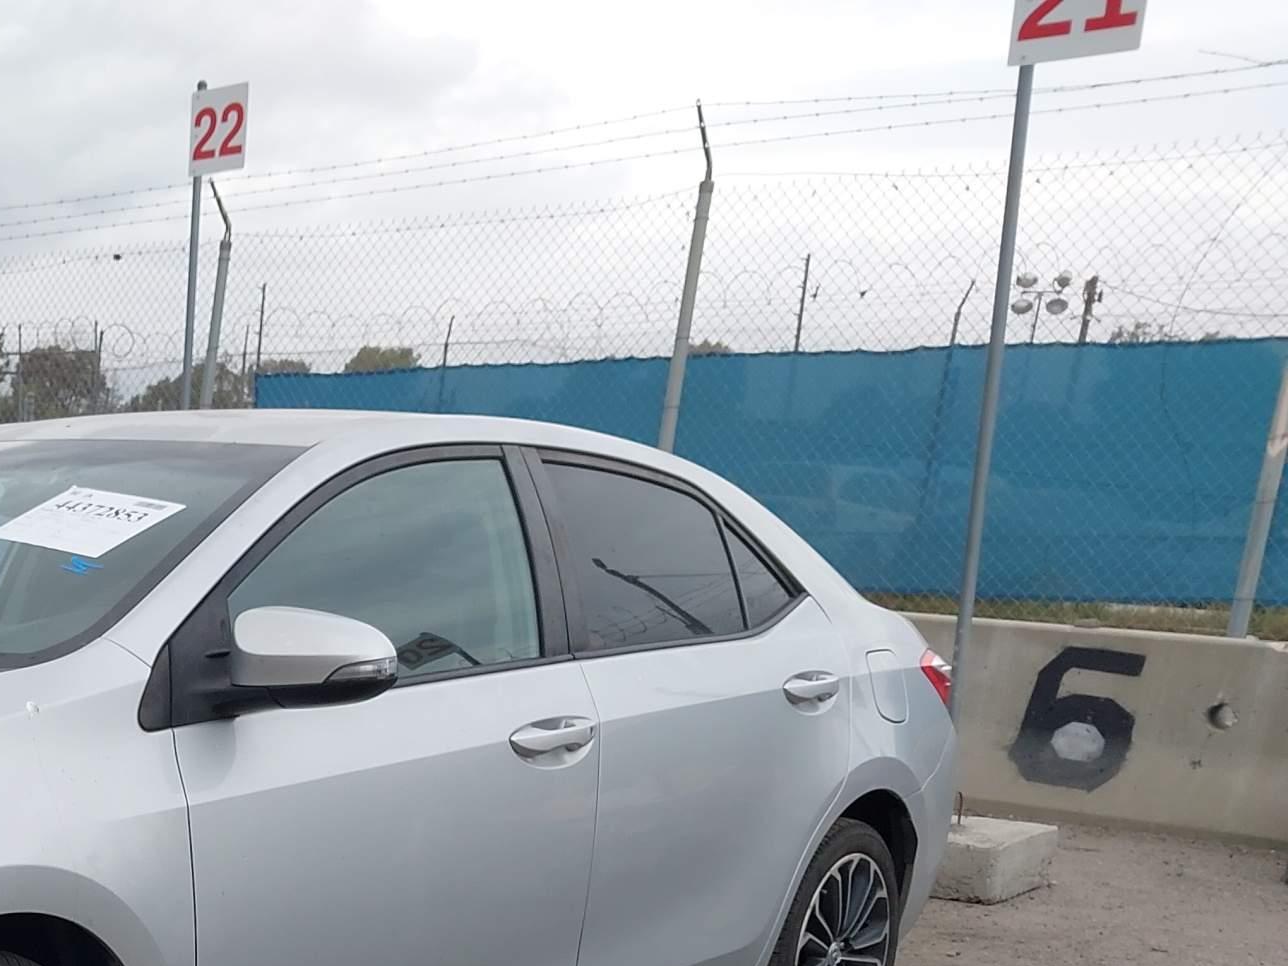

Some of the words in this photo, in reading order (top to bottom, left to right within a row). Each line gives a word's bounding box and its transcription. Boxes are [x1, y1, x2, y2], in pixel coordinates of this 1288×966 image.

[192, 102, 245, 161] 22
[54, 500, 149, 522] 44372853
[1007, 645, 1147, 793] 6
